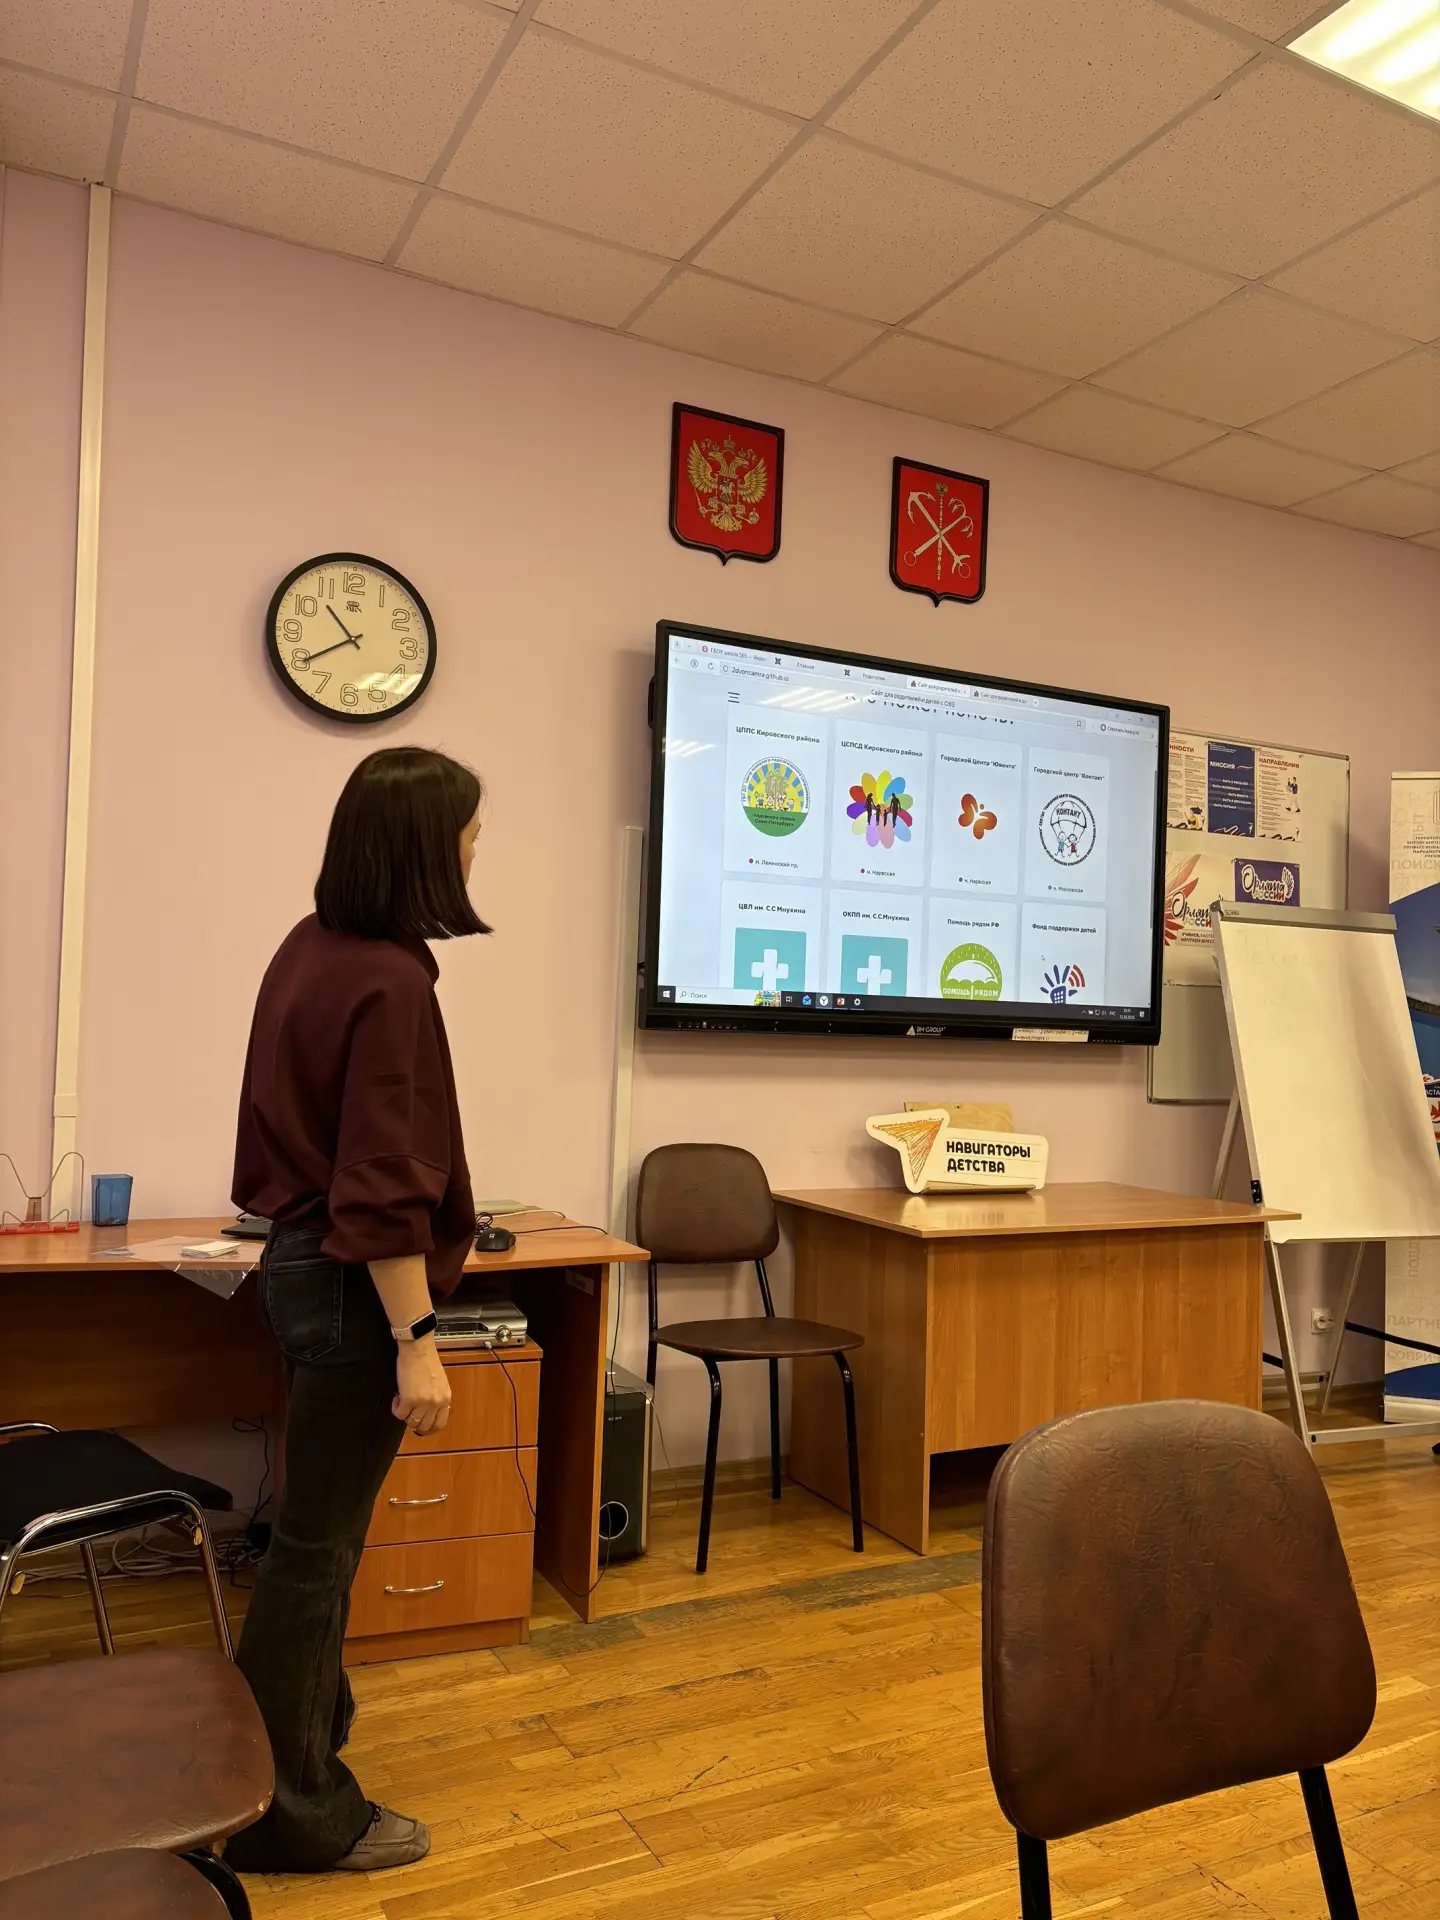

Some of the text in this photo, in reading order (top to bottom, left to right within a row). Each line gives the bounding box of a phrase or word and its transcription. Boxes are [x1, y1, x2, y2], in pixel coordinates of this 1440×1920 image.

[317, 576, 335, 600] 11
[342, 571, 366, 596] 12
[378, 584, 385, 608] 1
[294, 594, 318, 618] 10
[391, 608, 411, 632] 2
[282, 618, 302, 642] 9
[399, 636, 418, 660] 3
[290, 648, 310, 672] 8
[312, 670, 332, 694] 7
[388, 664, 407, 686] 4
[340, 683, 358, 706] 6
[368, 680, 386, 703] 5
[736, 725, 820, 743] ЦППС Кировского района
[841, 740, 923, 757] ЦСПСД Кировского района
[940, 754, 972, 764] Городской
[972, 758, 990, 767] Центр
[1210, 761, 1235, 770] МИССИЯ
[1259, 758, 1300, 769] НАПРАВЛЕНИЯ
[1033, 767, 1062, 776] Городской
[1063, 770, 1079, 779] центр
[1056, 808, 1081, 818] КОНТАКТ
[1243, 866, 1285, 894] Орлята
[1253, 891, 1285, 900] РОССИИ
[738, 903, 753, 911] ЦВЛ
[948, 919, 971, 927] Помощь
[1048, 925, 1080, 933] поддержки
[690, 991, 708, 999] Поиск
[943, 988, 970, 996] ПОМОЩЬ
[946, 1141, 1031, 1158] НАВИГАТОРЫ
[947, 1158, 1005, 1173] ДЕТСТВА
